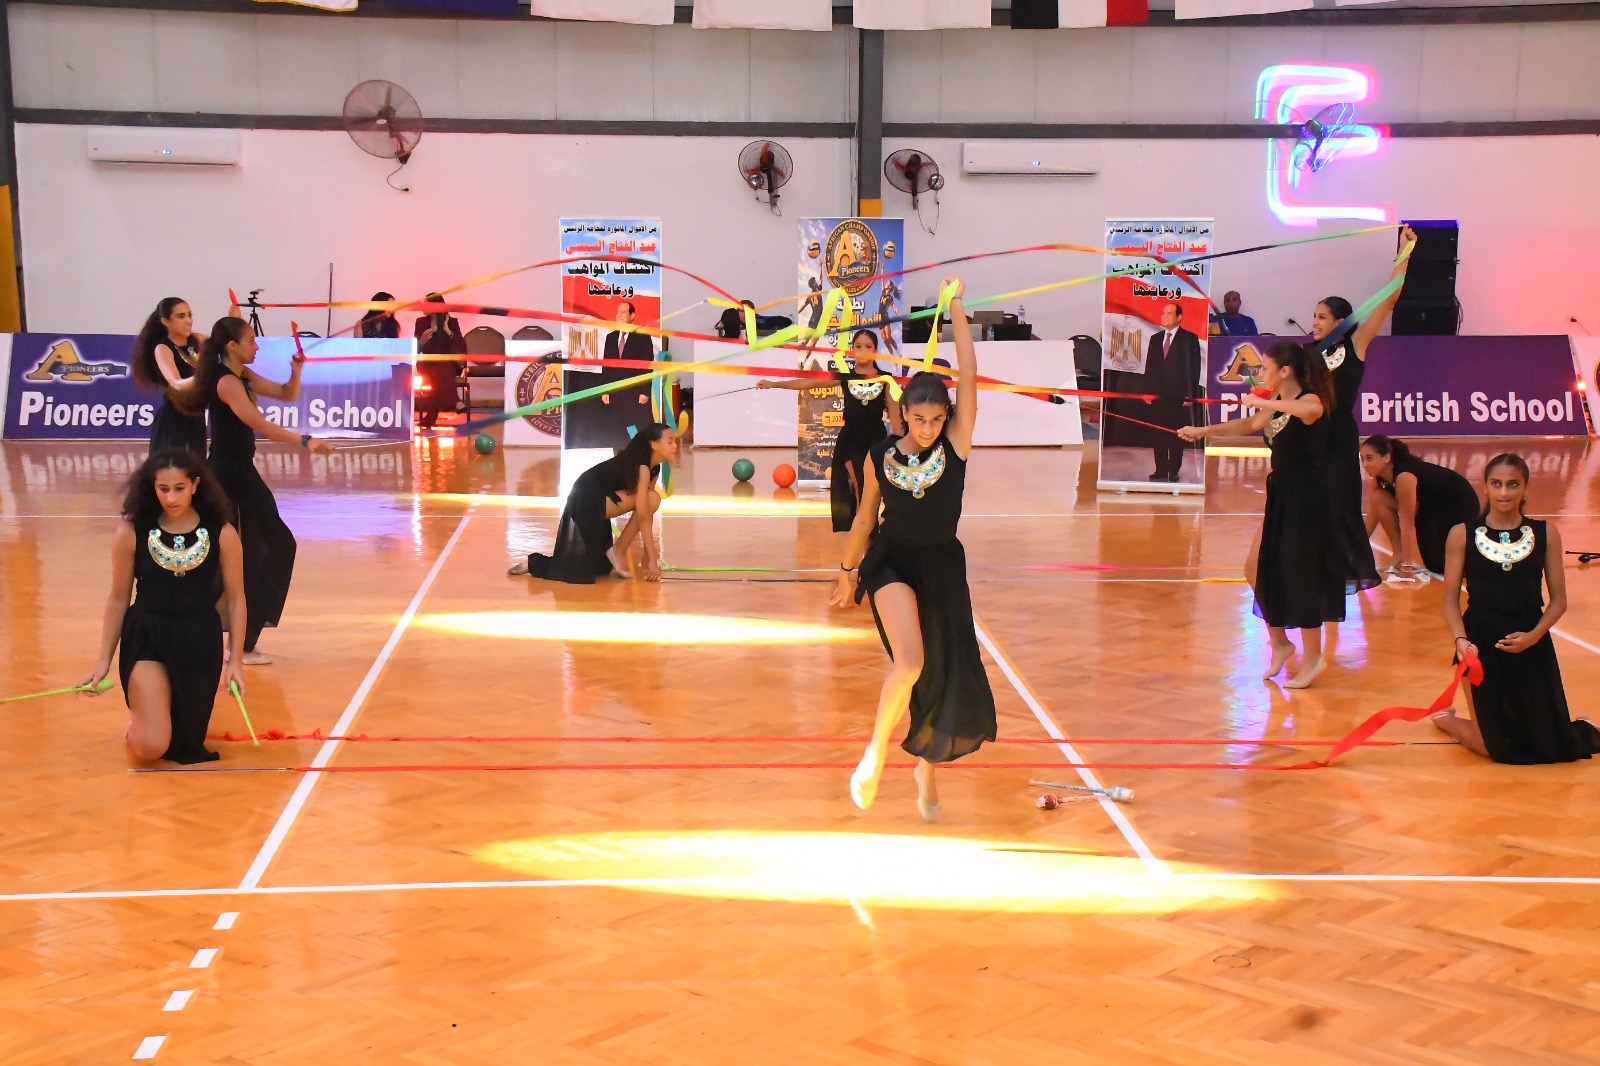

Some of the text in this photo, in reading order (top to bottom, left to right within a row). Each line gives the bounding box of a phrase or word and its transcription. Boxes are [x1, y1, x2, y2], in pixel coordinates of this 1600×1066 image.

[608, 240, 636, 255] الفتاح
[639, 242, 657, 253] عبد
[1157, 241, 1186, 256] الفتاح
[1189, 243, 1207, 255] عبد
[567, 262, 609, 277] المواهب
[841, 265, 870, 277] Pioneers
[588, 284, 634, 299] ورعايتها
[1133, 284, 1182, 299] ورعايتها
[836, 297, 866, 313] بطة
[61, 365, 110, 373] PIONEERS
[18, 391, 154, 427] Pioneers
[308, 398, 402, 428] School
[1361, 391, 1573, 423] British School
